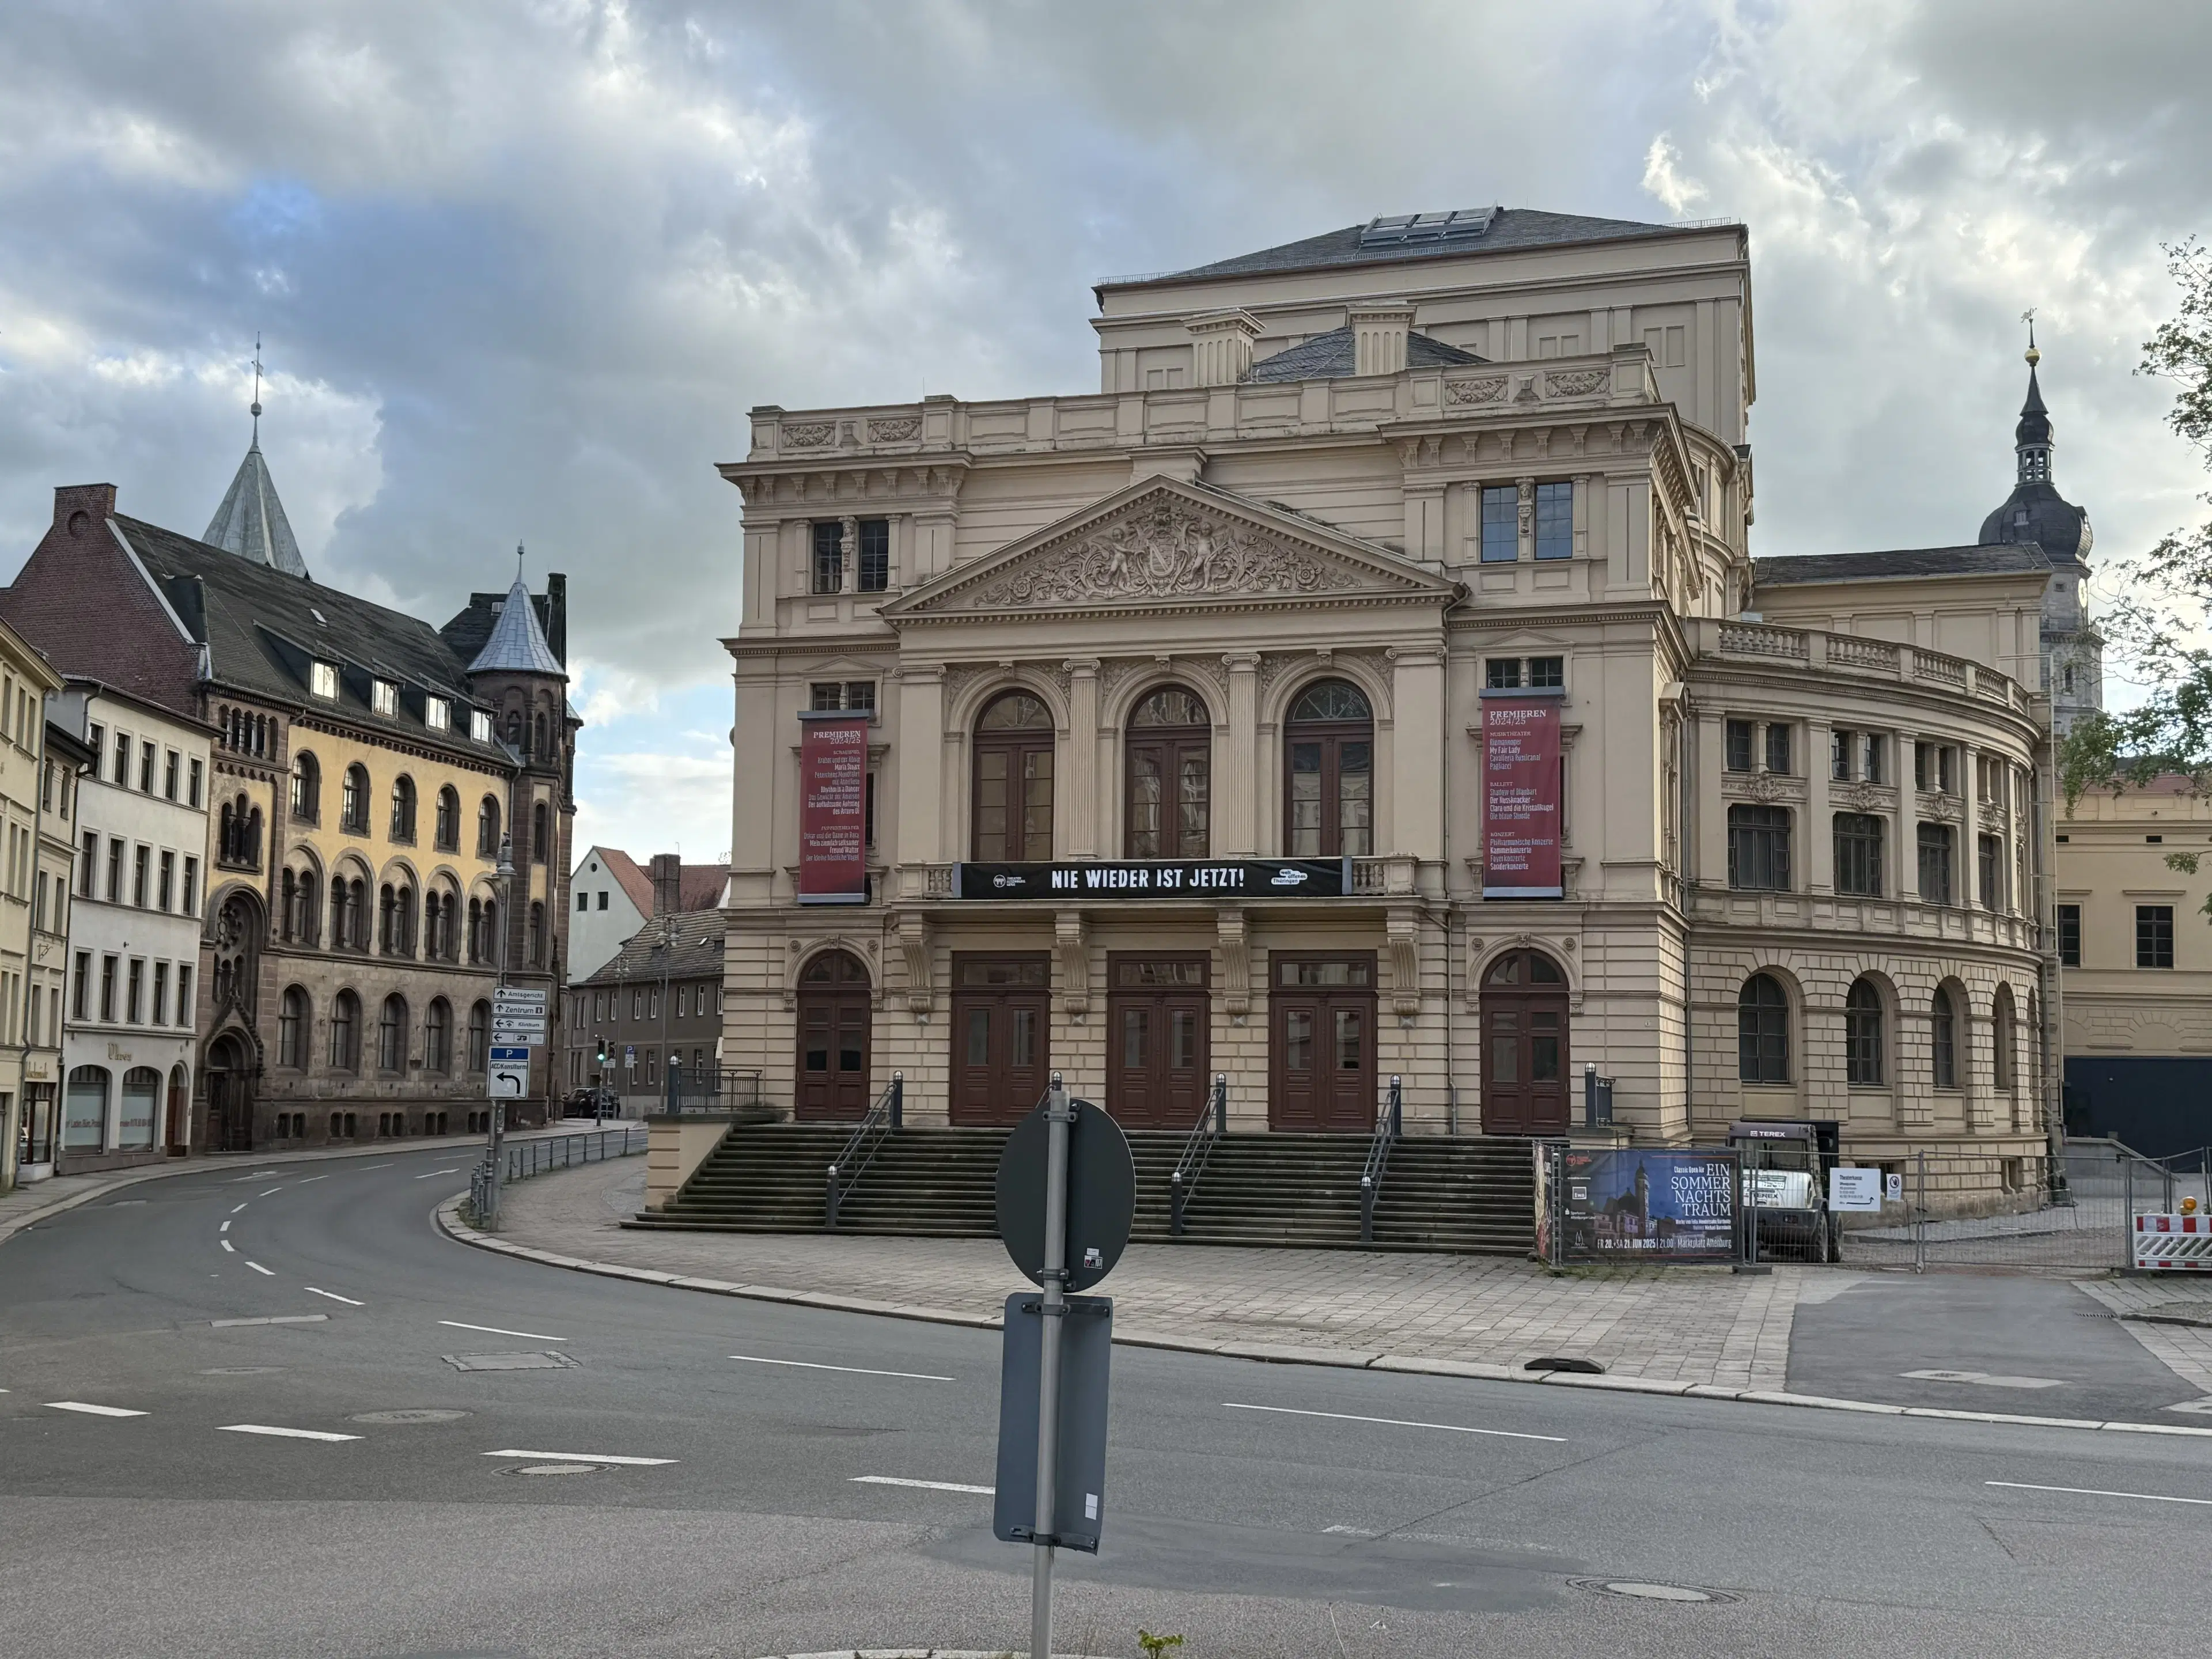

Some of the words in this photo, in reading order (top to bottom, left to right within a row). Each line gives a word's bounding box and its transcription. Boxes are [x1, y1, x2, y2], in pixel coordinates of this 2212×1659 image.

[1490, 710, 1546, 718] PREMIEREN
[1490, 718, 1526, 726] 2024/25
[813, 730, 861, 738] PREMIEREN
[1052, 870, 1078, 888] NIE
[1085, 869, 1149, 888] WIEDER
[1156, 869, 1183, 887] IST
[1189, 868, 1244, 887] JETZT!
[506, 1050, 513, 1058] P
[1706, 1164, 1730, 1176] EIN
[1671, 1176, 1731, 1190] SOMMER
[1675, 1190, 1731, 1203] NACHTS
[1682, 1203, 1732, 1216] TRAUM
[1597, 1238, 1604, 1248] FR
[1633, 1238, 1642, 1248] JUN
[1643, 1238, 1656, 1248] 2025
